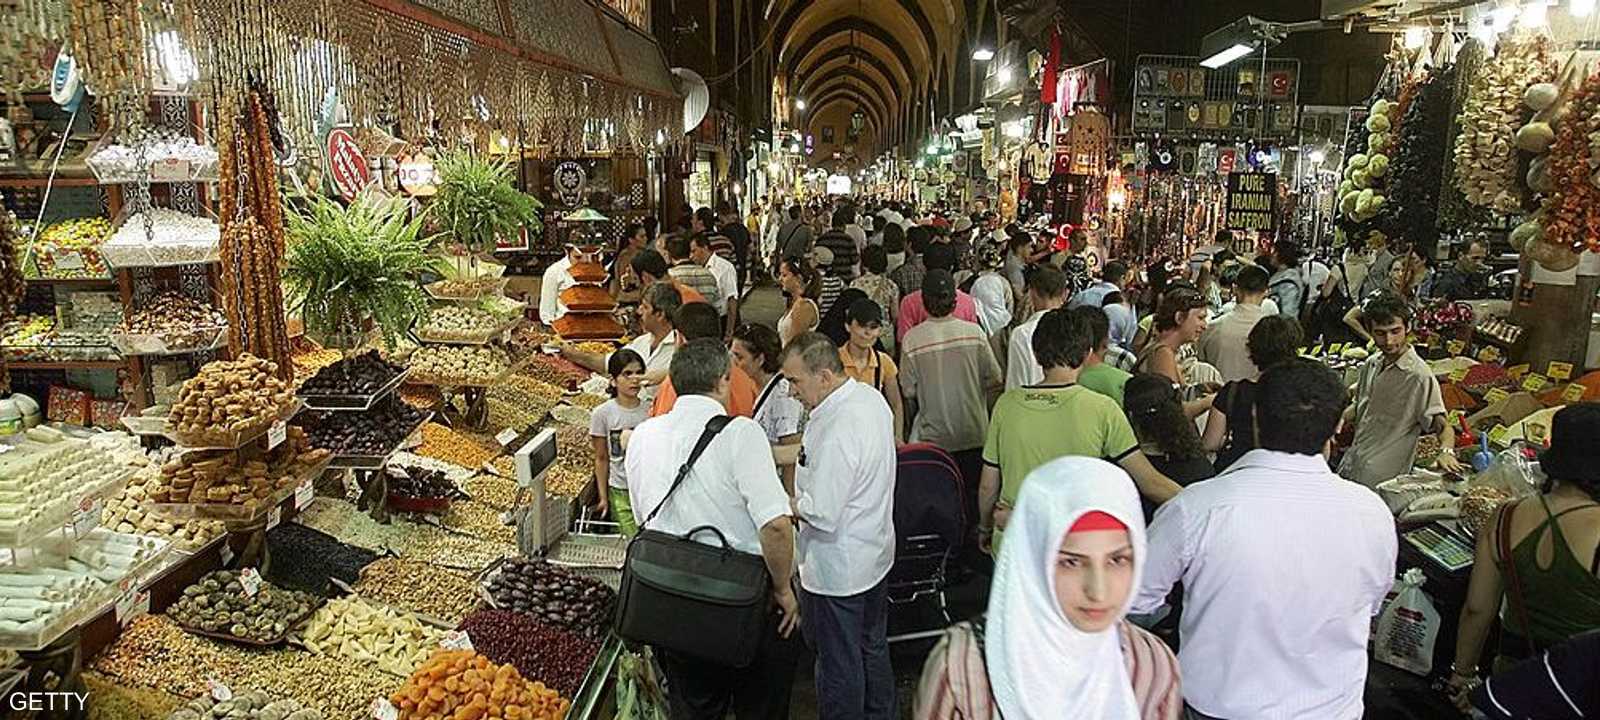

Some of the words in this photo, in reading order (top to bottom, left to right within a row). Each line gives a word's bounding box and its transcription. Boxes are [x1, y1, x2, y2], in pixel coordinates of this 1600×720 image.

[1238, 174, 1265, 191] PURE
[1231, 193, 1272, 211] IRANIAN
[1227, 211, 1272, 230] SAFFRON
